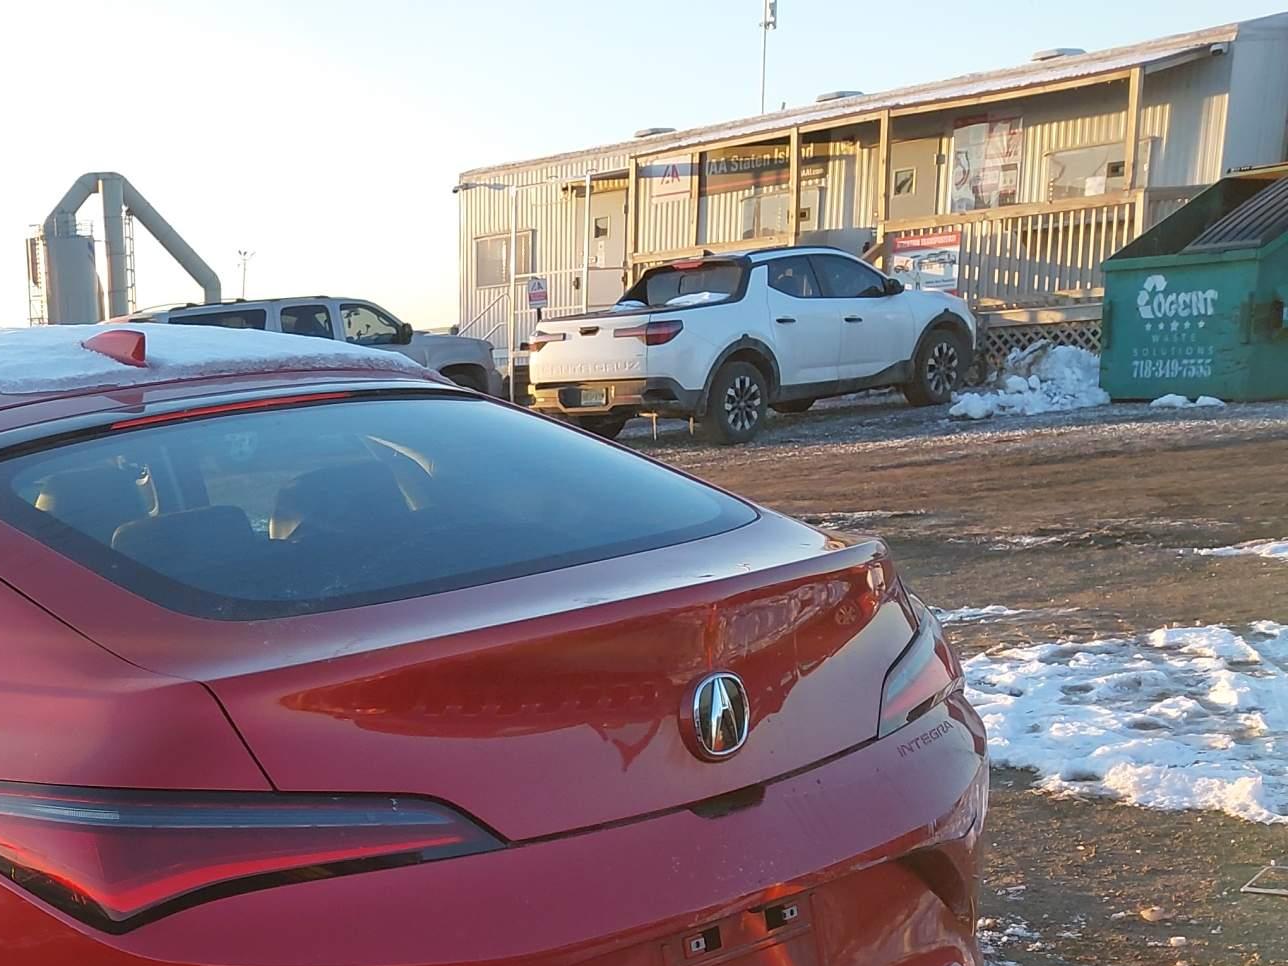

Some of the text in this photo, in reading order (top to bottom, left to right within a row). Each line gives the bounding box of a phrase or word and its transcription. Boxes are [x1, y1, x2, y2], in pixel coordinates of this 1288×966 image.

[731, 153, 771, 172] Staten
[774, 142, 814, 164] Islnd
[1152, 333, 1196, 342] WASTE
[1132, 345, 1214, 356] SOLUTIONS
[897, 720, 954, 757] INTEGRA
